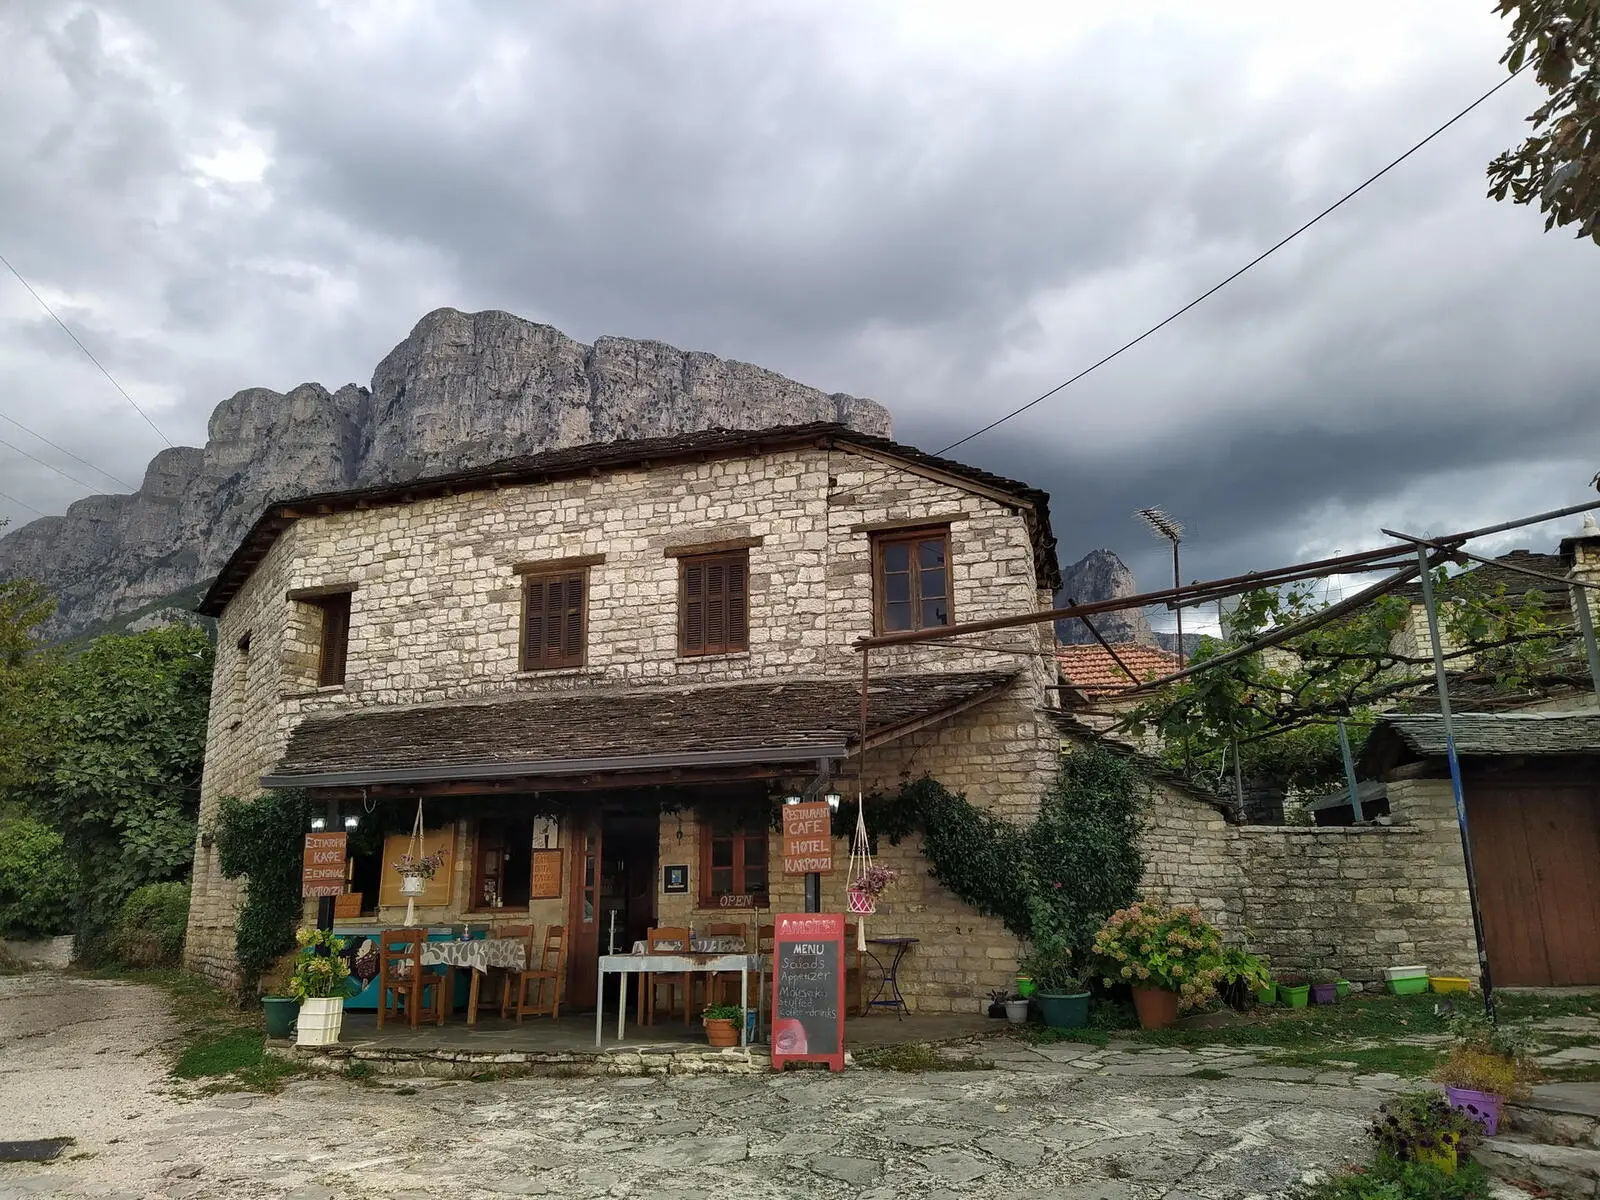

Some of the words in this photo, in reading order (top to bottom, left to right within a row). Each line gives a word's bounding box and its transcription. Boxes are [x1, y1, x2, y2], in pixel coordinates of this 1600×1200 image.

[789, 820, 824, 835] CAFE
[791, 840, 829, 855] HOTEL
[313, 850, 341, 864] ΚΑΦΕ
[784, 857, 832, 873] KARPOUZI
[720, 895, 753, 907] OPEN
[793, 943, 825, 955] MENU
[781, 957, 825, 970] Salads
